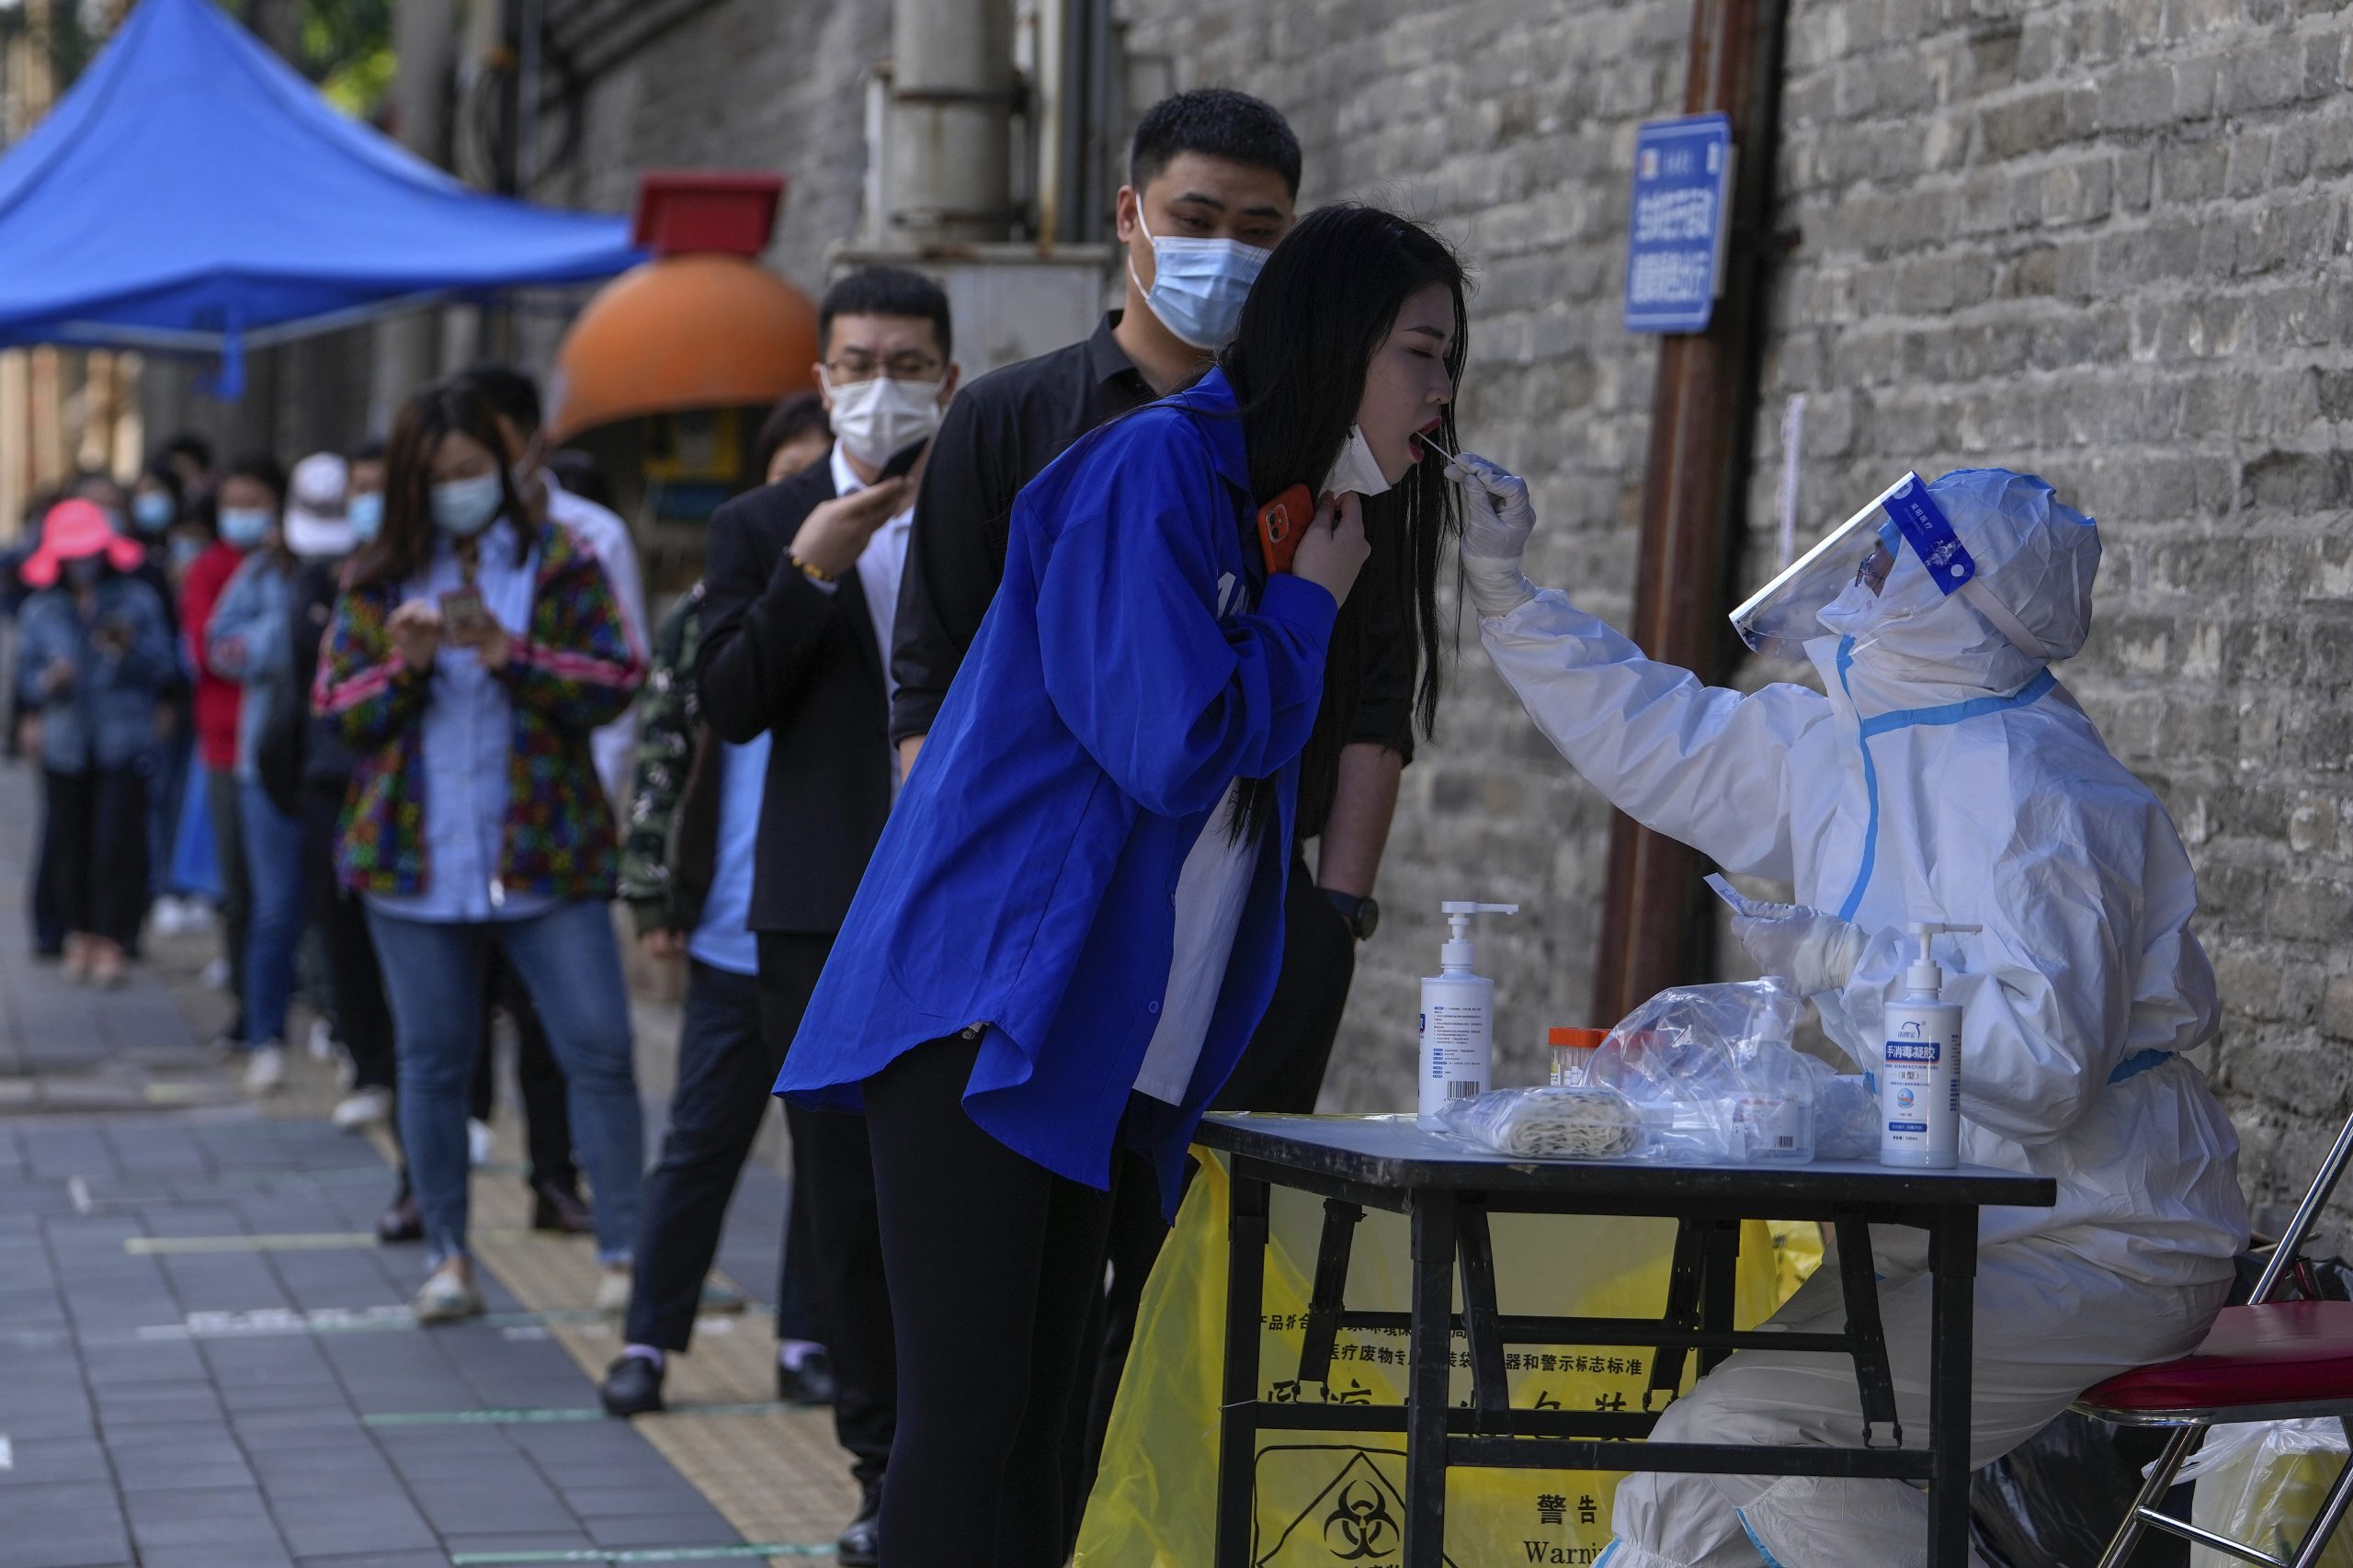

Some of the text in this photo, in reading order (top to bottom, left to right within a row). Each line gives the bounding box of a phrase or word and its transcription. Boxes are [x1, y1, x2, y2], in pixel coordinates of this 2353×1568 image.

[1887, 1045, 1936, 1060] 手消毒凝胶
[1537, 1494, 1597, 1525] 警告
[1523, 1540, 1603, 1564] Warni
